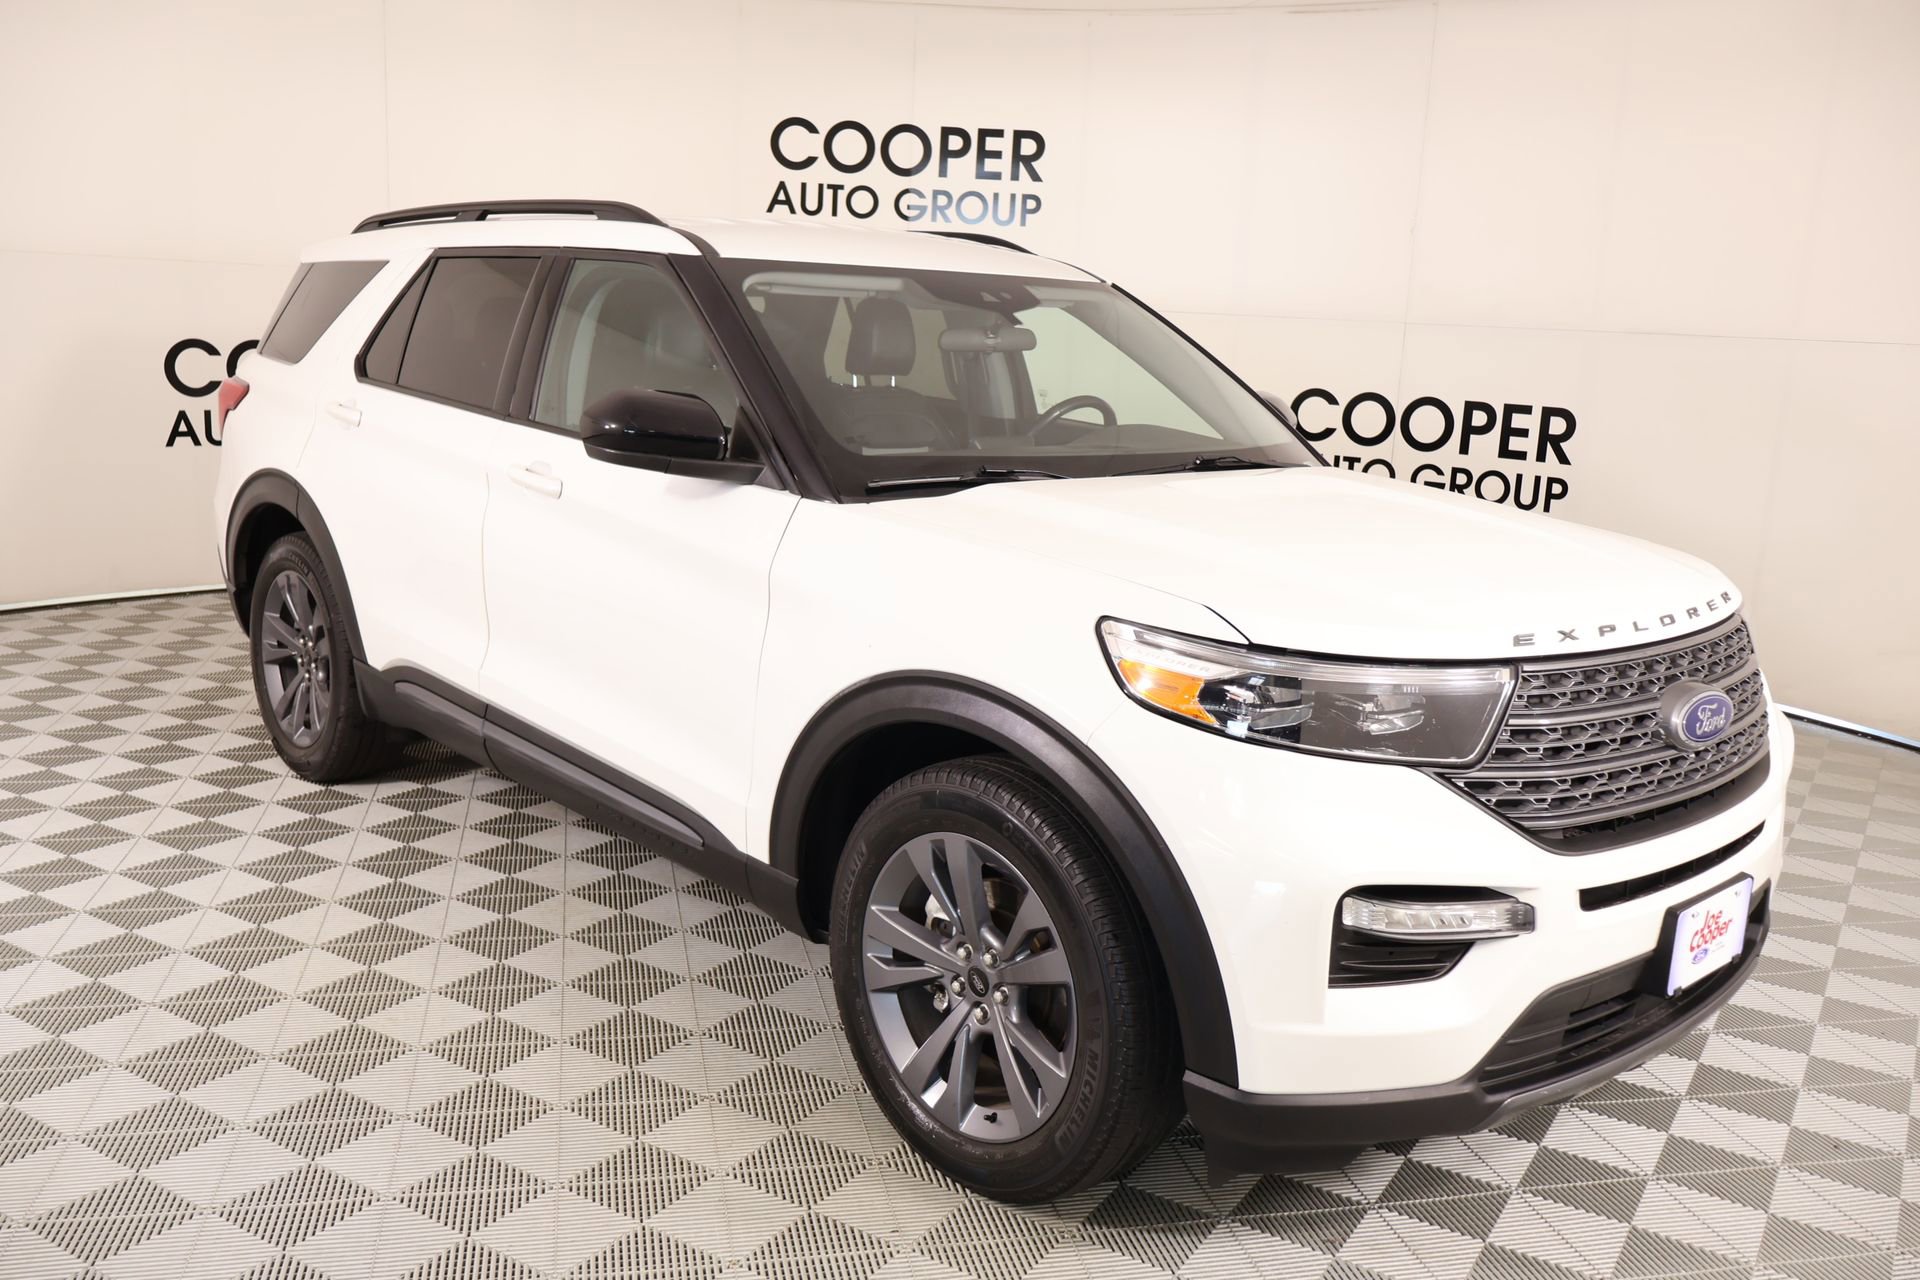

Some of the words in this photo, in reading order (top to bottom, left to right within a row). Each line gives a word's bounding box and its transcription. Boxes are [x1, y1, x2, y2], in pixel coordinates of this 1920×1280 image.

[770, 116, 1046, 183] COOPER
[766, 180, 879, 219] AUTO
[894, 187, 1042, 227] GROUP
[1290, 388, 1577, 466] COOPER
[1513, 591, 1731, 647] EXPLORER
[1696, 703, 1726, 735] Ford
[1690, 918, 1733, 953] Cooper
[1700, 910, 1723, 933] Joe
[1058, 1047, 1100, 1146] MICHELIN
